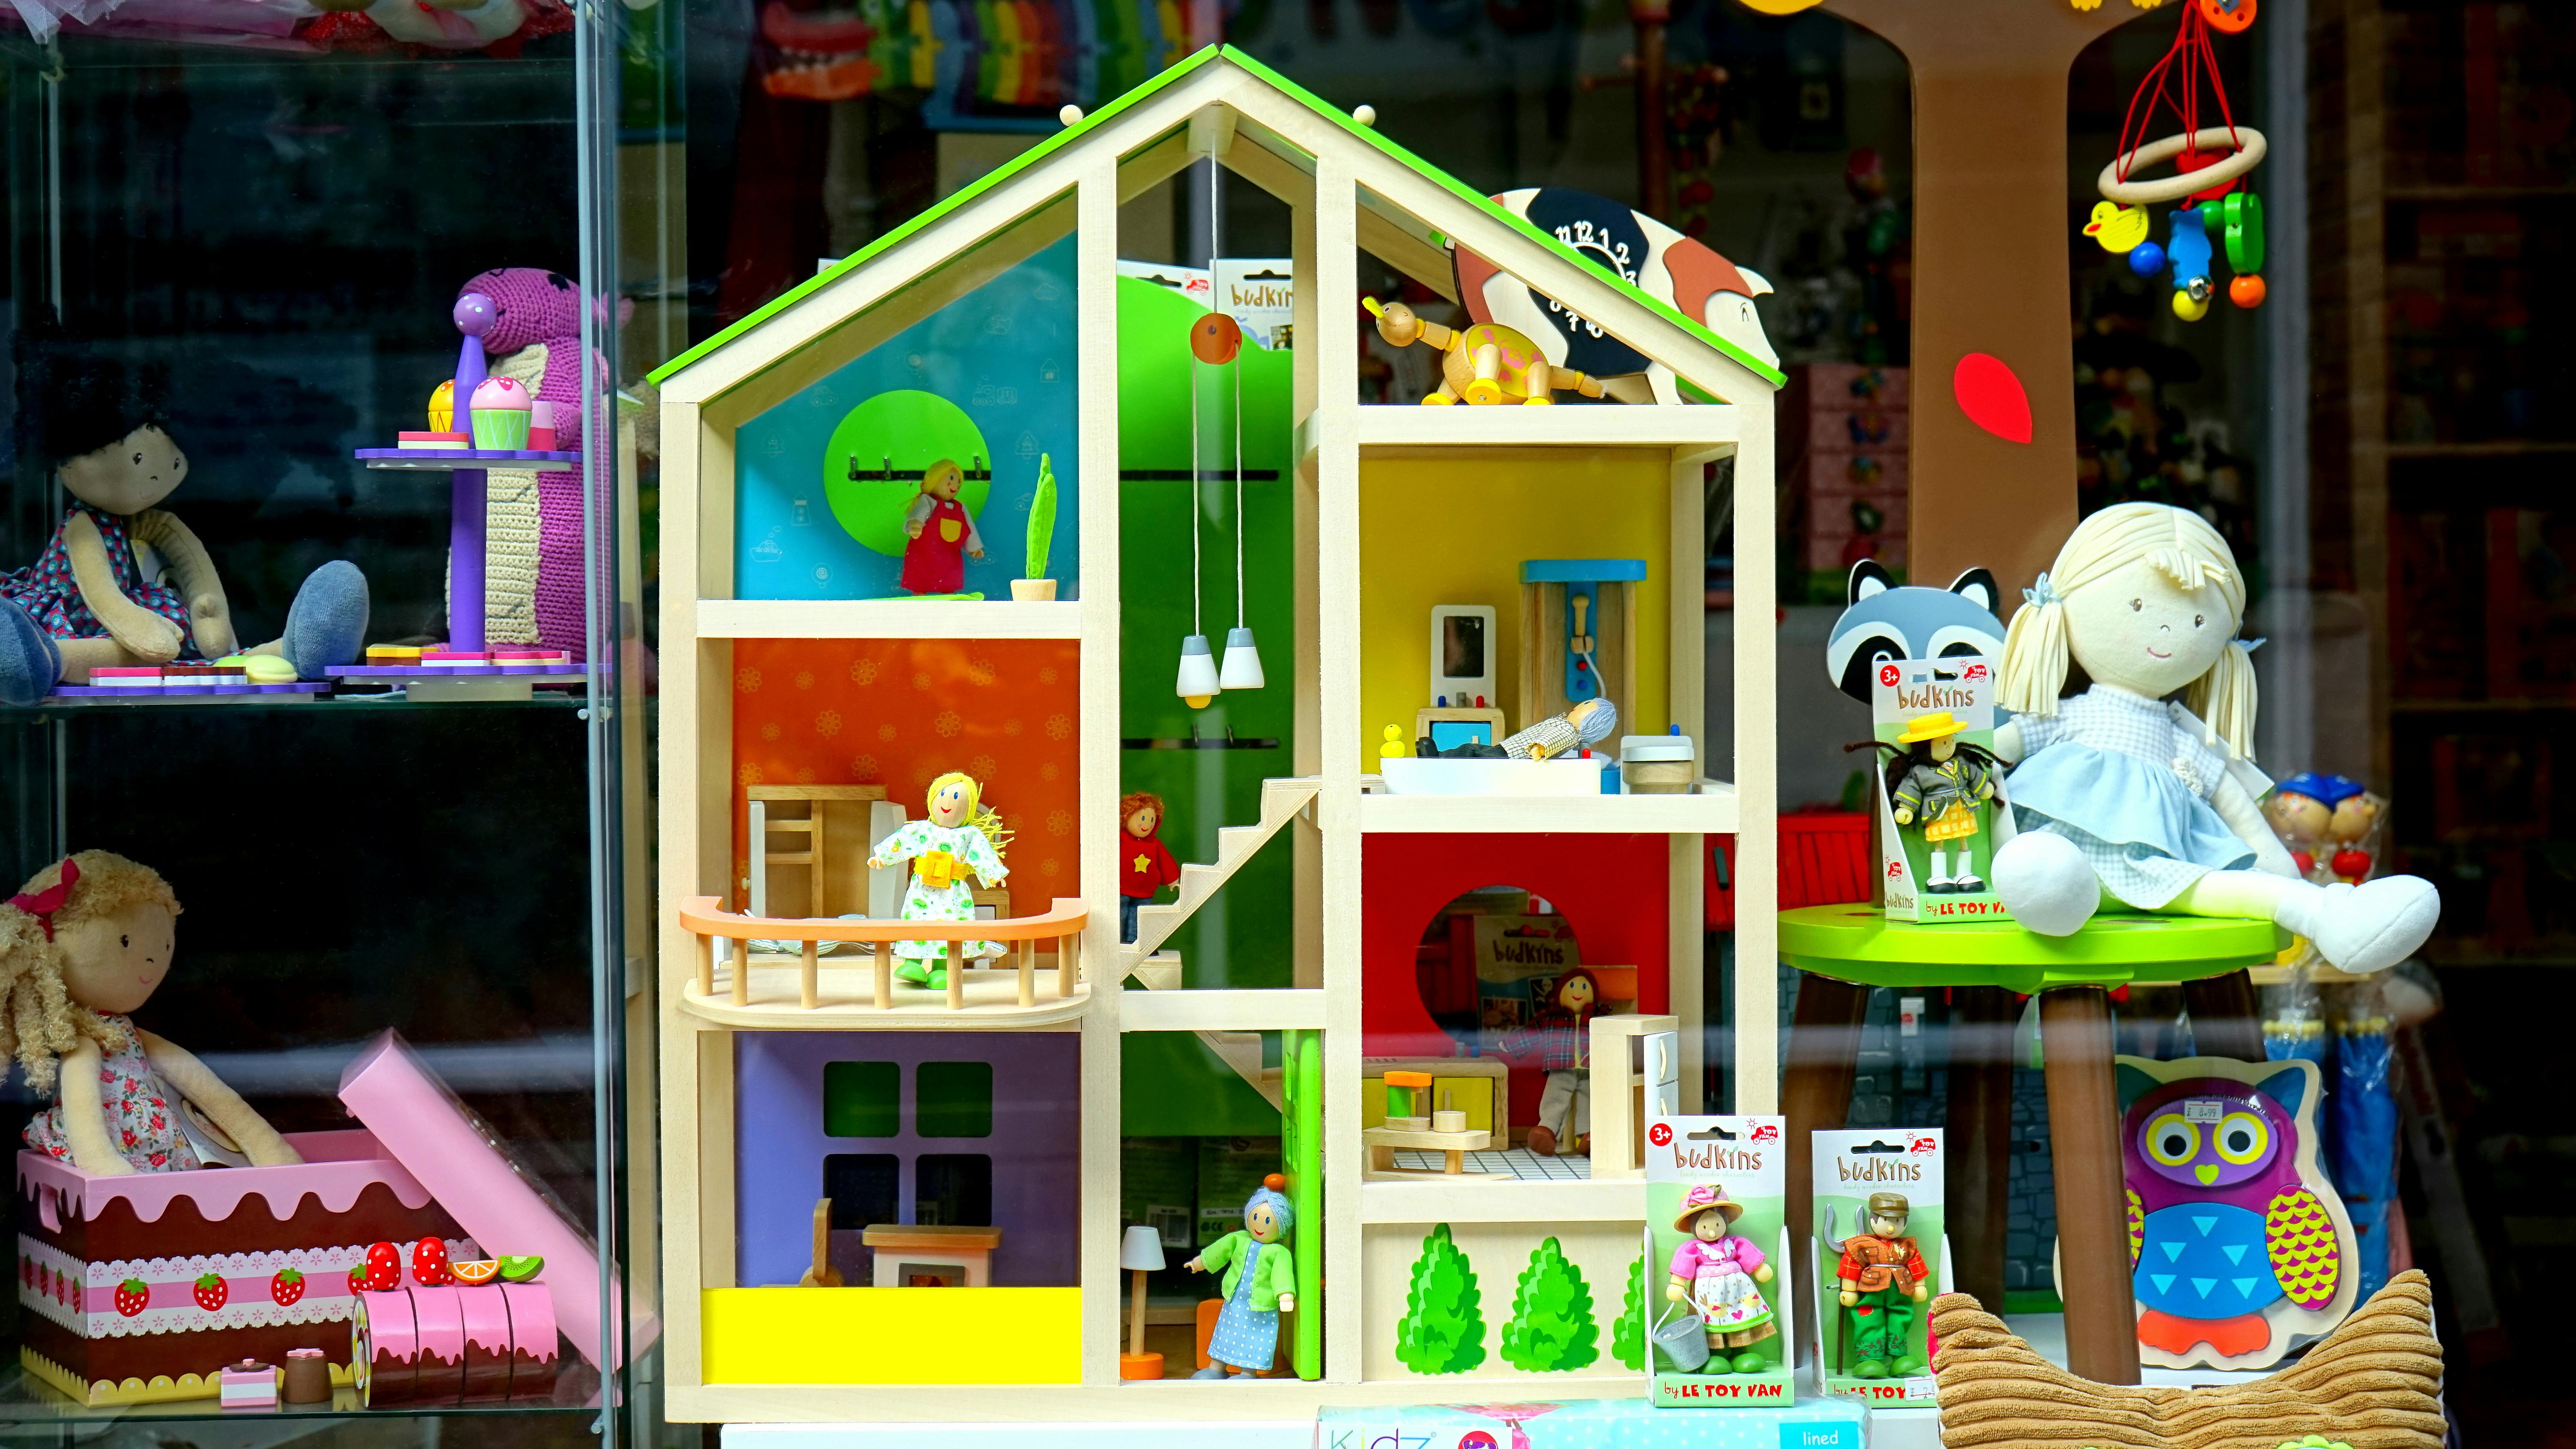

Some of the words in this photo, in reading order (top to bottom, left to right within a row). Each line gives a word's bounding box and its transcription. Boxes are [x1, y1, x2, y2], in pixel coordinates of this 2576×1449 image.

[1555, 226, 1571, 243] 11
[1574, 220, 1593, 242] 12
[1600, 228, 1609, 249] 1
[1617, 242, 1630, 264] 2
[1231, 284, 1292, 307] budkin
[1884, 669, 1898, 682] 3+
[1897, 684, 1974, 709] budkins
[1885, 892, 1914, 908] budkins
[1926, 901, 1938, 916] by
[1940, 903, 1954, 915] LE
[1959, 902, 1987, 914] TOY
[1493, 940, 1564, 964] budkins
[1654, 1127, 1671, 1141] 3+
[1674, 1142, 1762, 1170] budkins
[1838, 1156, 1921, 1181] budkins
[1664, 1382, 1679, 1399] by
[1682, 1384, 1699, 1397] LE
[1704, 1384, 1741, 1397] TOY
[1747, 1383, 1782, 1398] VAN
[1872, 1386, 1905, 1399] TOY
[1803, 1430, 1838, 1446] lined
